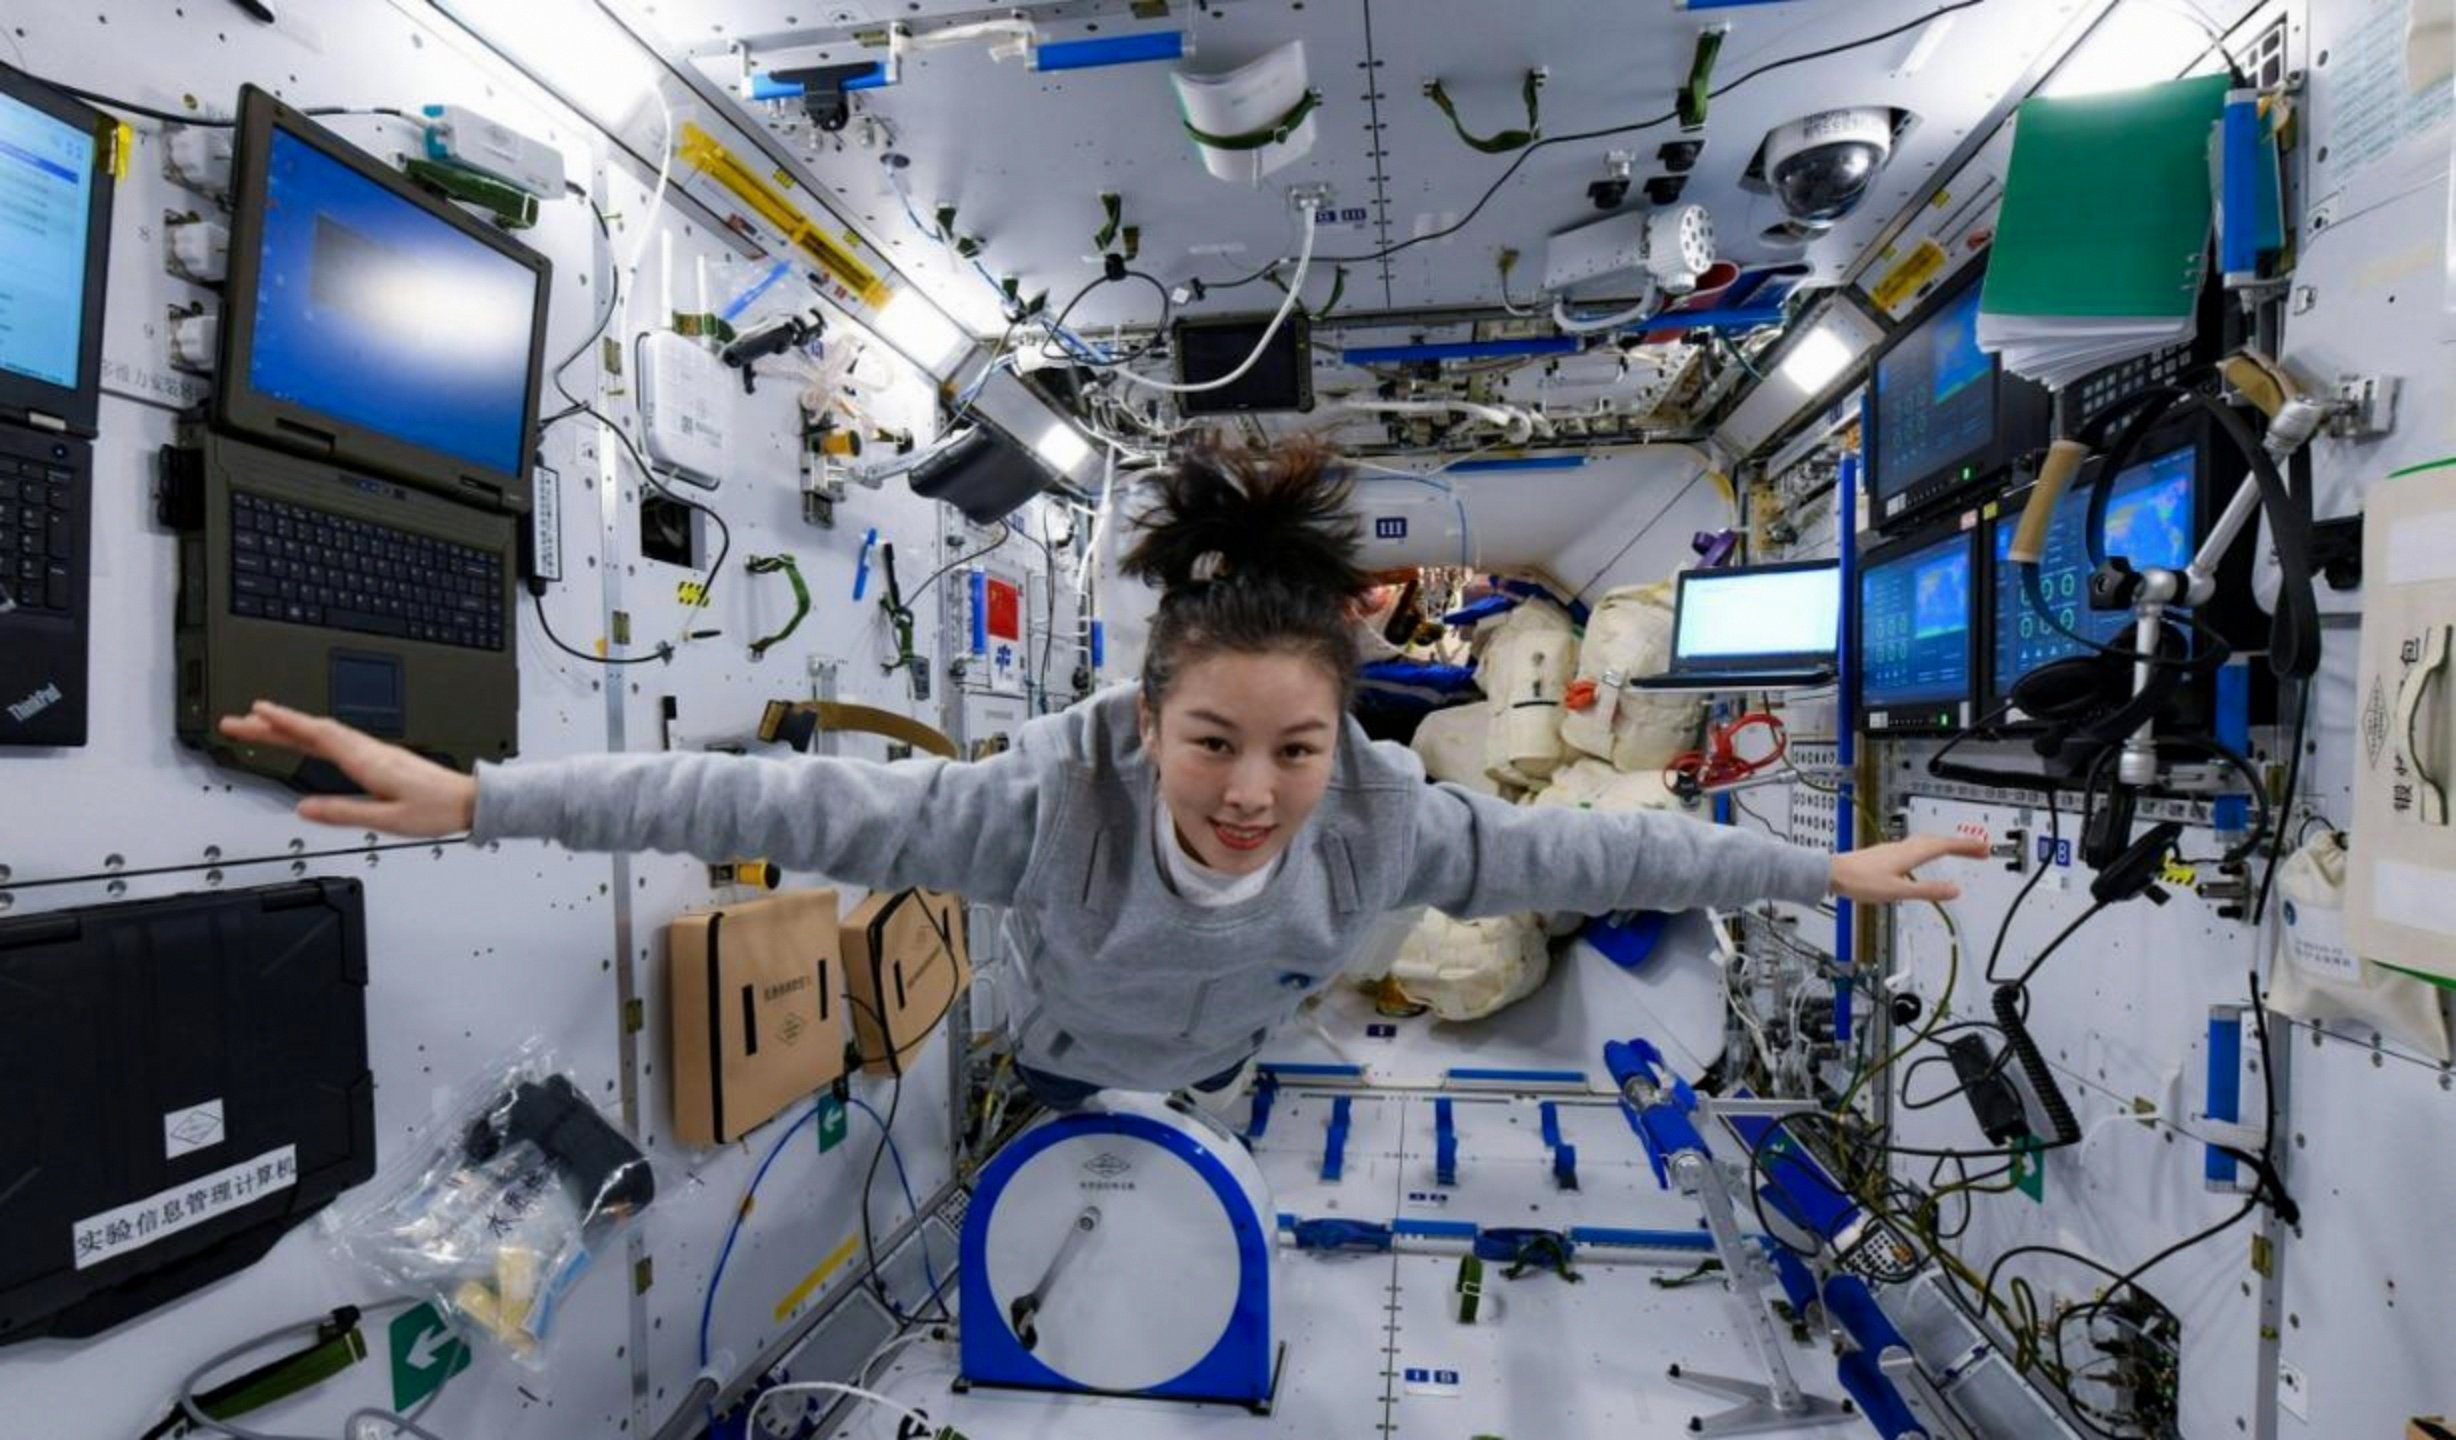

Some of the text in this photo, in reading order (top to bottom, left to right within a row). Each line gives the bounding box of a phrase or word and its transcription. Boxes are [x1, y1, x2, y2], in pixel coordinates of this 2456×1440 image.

[6, 682, 62, 722] ThinkPad
[77, 1157, 296, 1259] 实验信息管理计算机
